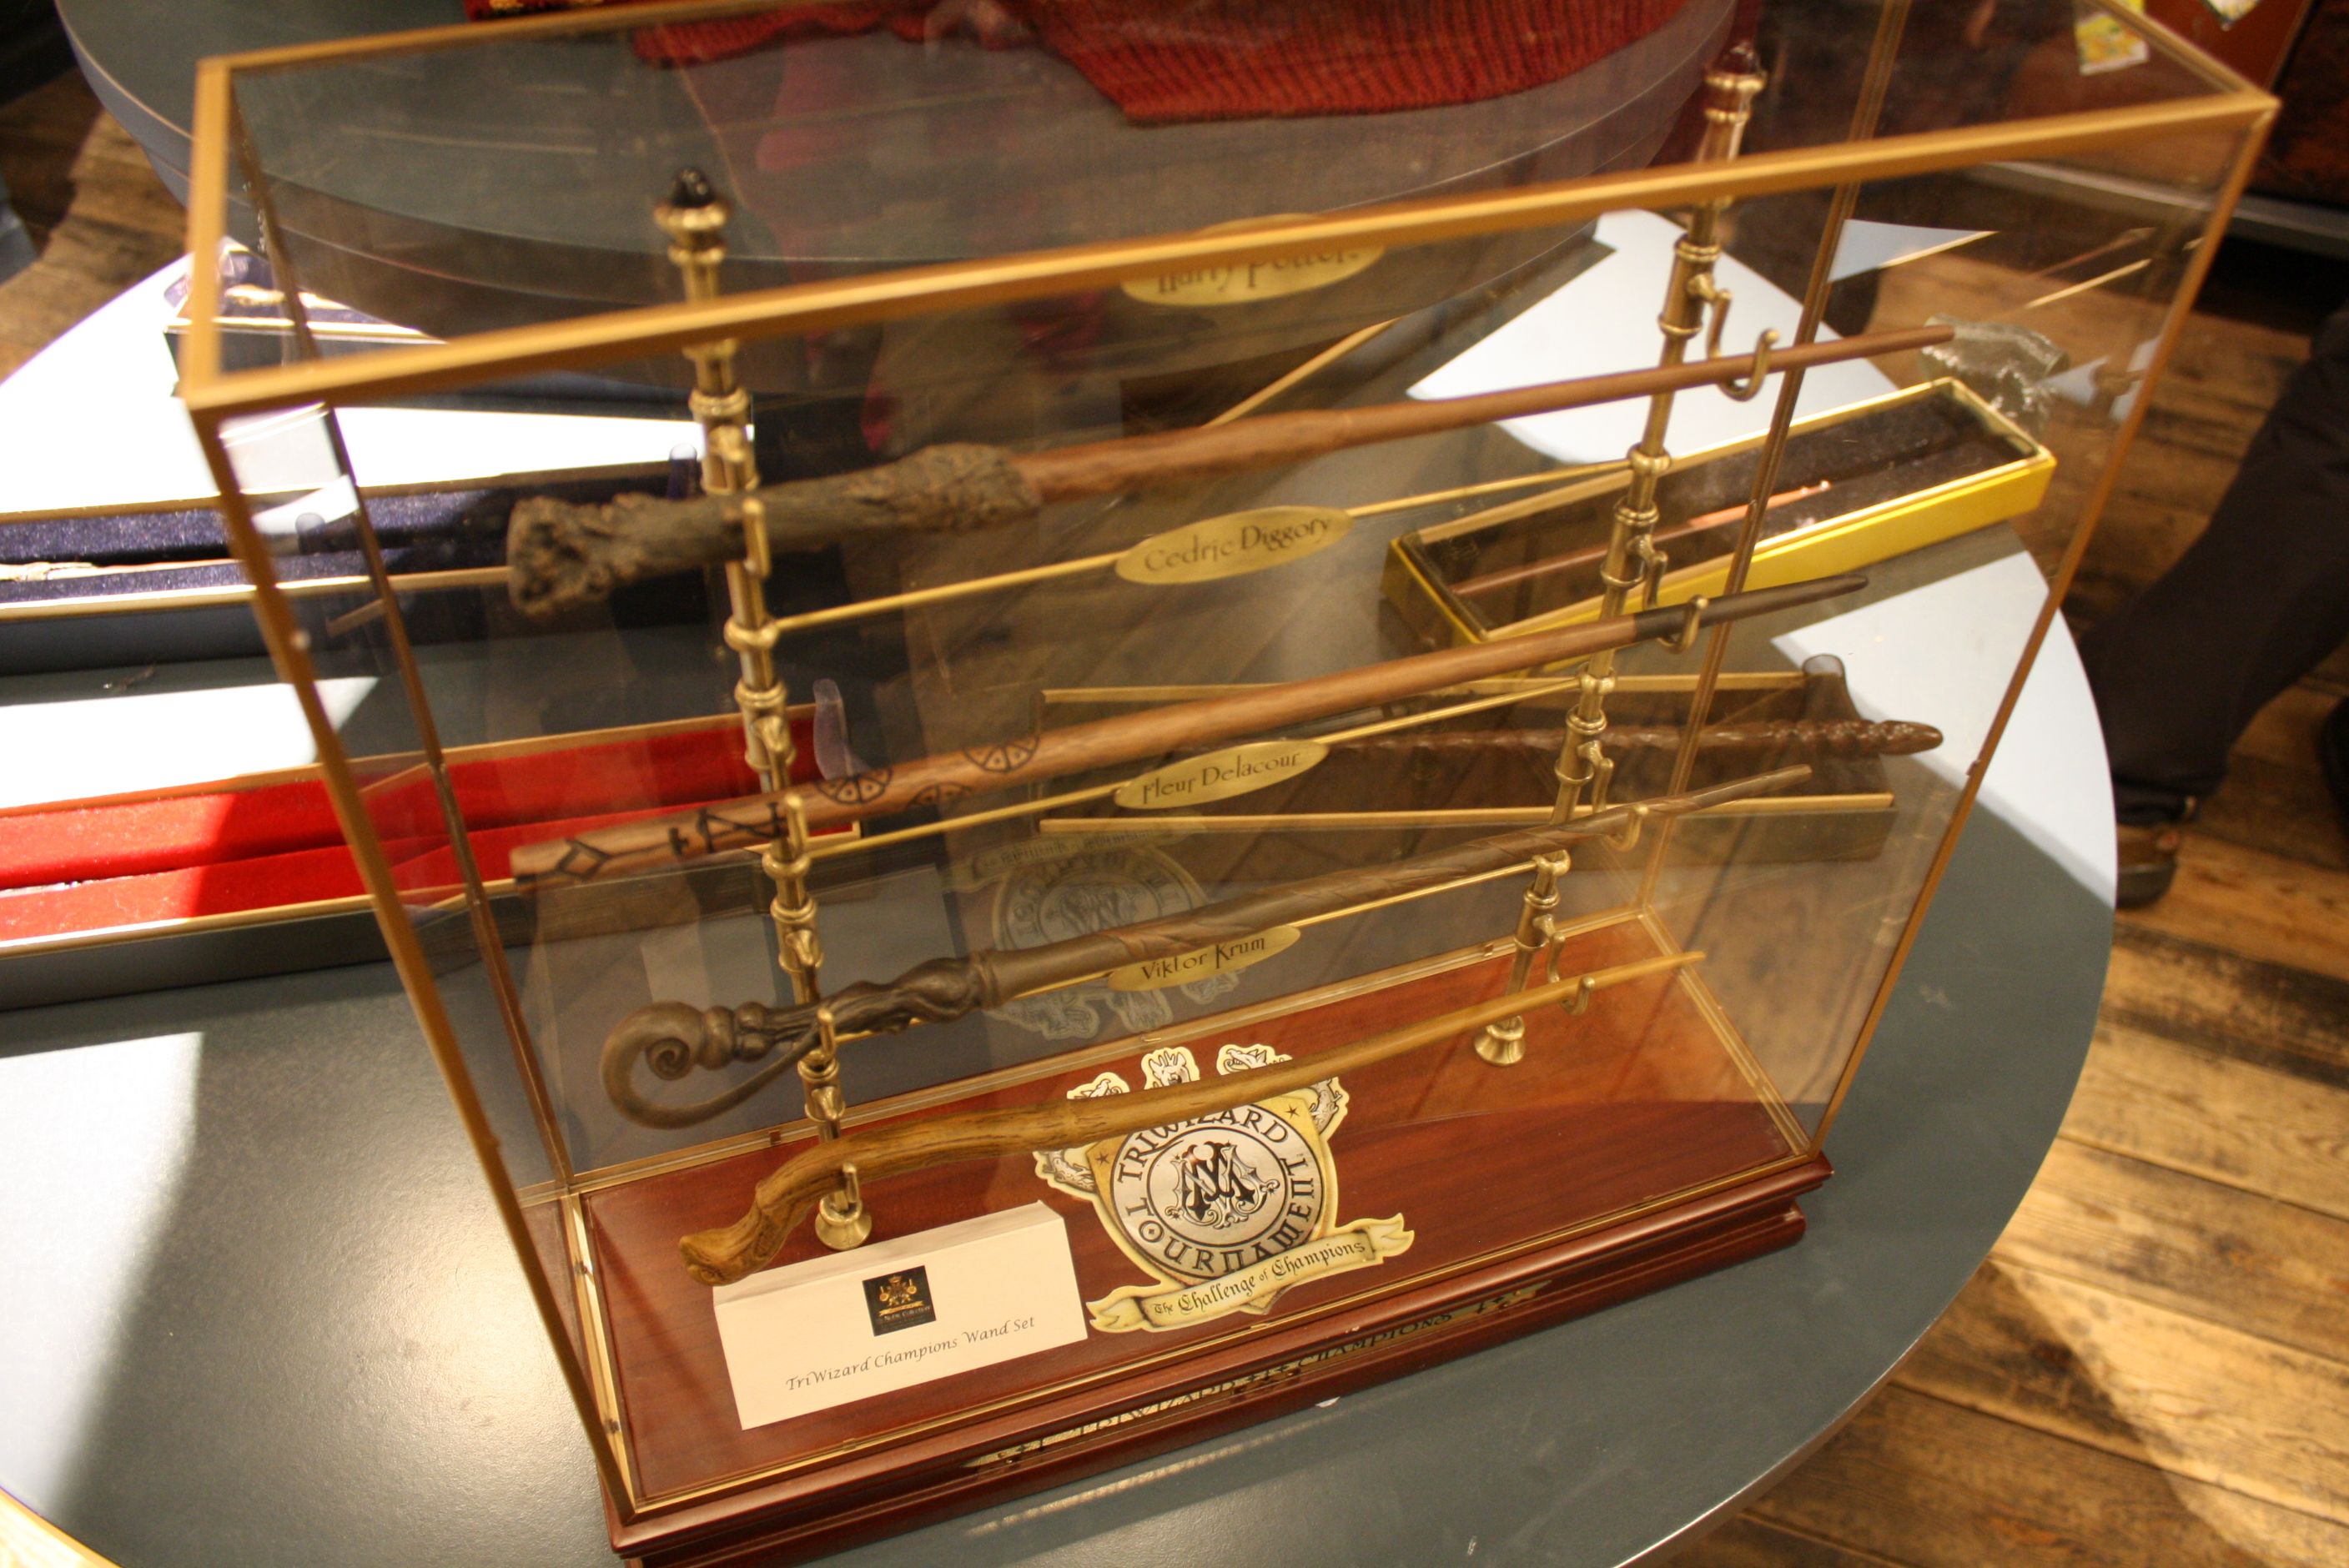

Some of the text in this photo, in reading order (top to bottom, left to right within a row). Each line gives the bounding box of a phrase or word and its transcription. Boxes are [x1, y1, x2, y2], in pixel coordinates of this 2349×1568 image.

[1144, 518, 1329, 571] Cedric Diggory
[1142, 752, 1300, 804] Fleur Delacour
[1140, 937, 1265, 981] Viktor Krum
[1154, 1242, 1366, 1315] The Challenge of Champions
[786, 1316, 1036, 1391] TriWizard Champions Wand Set
